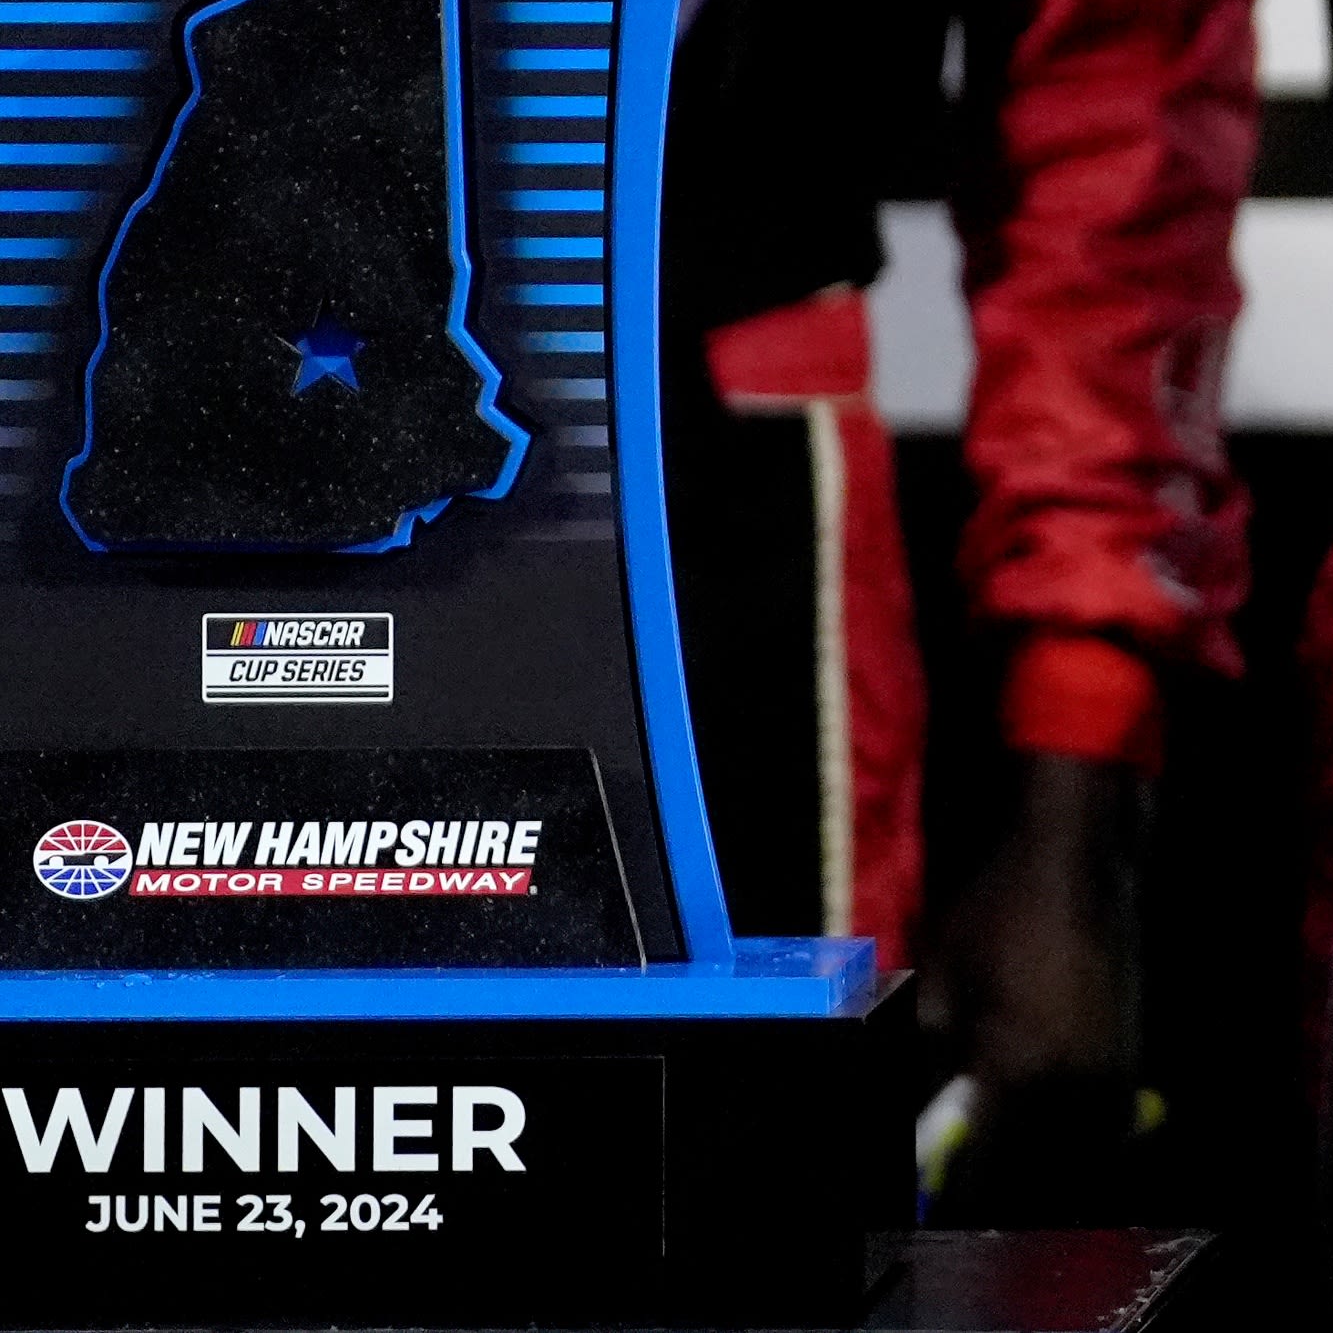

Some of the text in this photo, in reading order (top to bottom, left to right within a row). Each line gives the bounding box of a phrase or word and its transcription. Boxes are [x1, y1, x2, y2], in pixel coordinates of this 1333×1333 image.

[263, 620, 366, 647] NASCAR
[229, 659, 367, 682] CUP SERIES
[135, 819, 543, 867] NEW HAMPSHIRE
[135, 871, 527, 893] MOTOR SPEEDWAY
[1, 1086, 528, 1173] WINNER
[85, 1194, 444, 1239] JUNE 23, 2024
